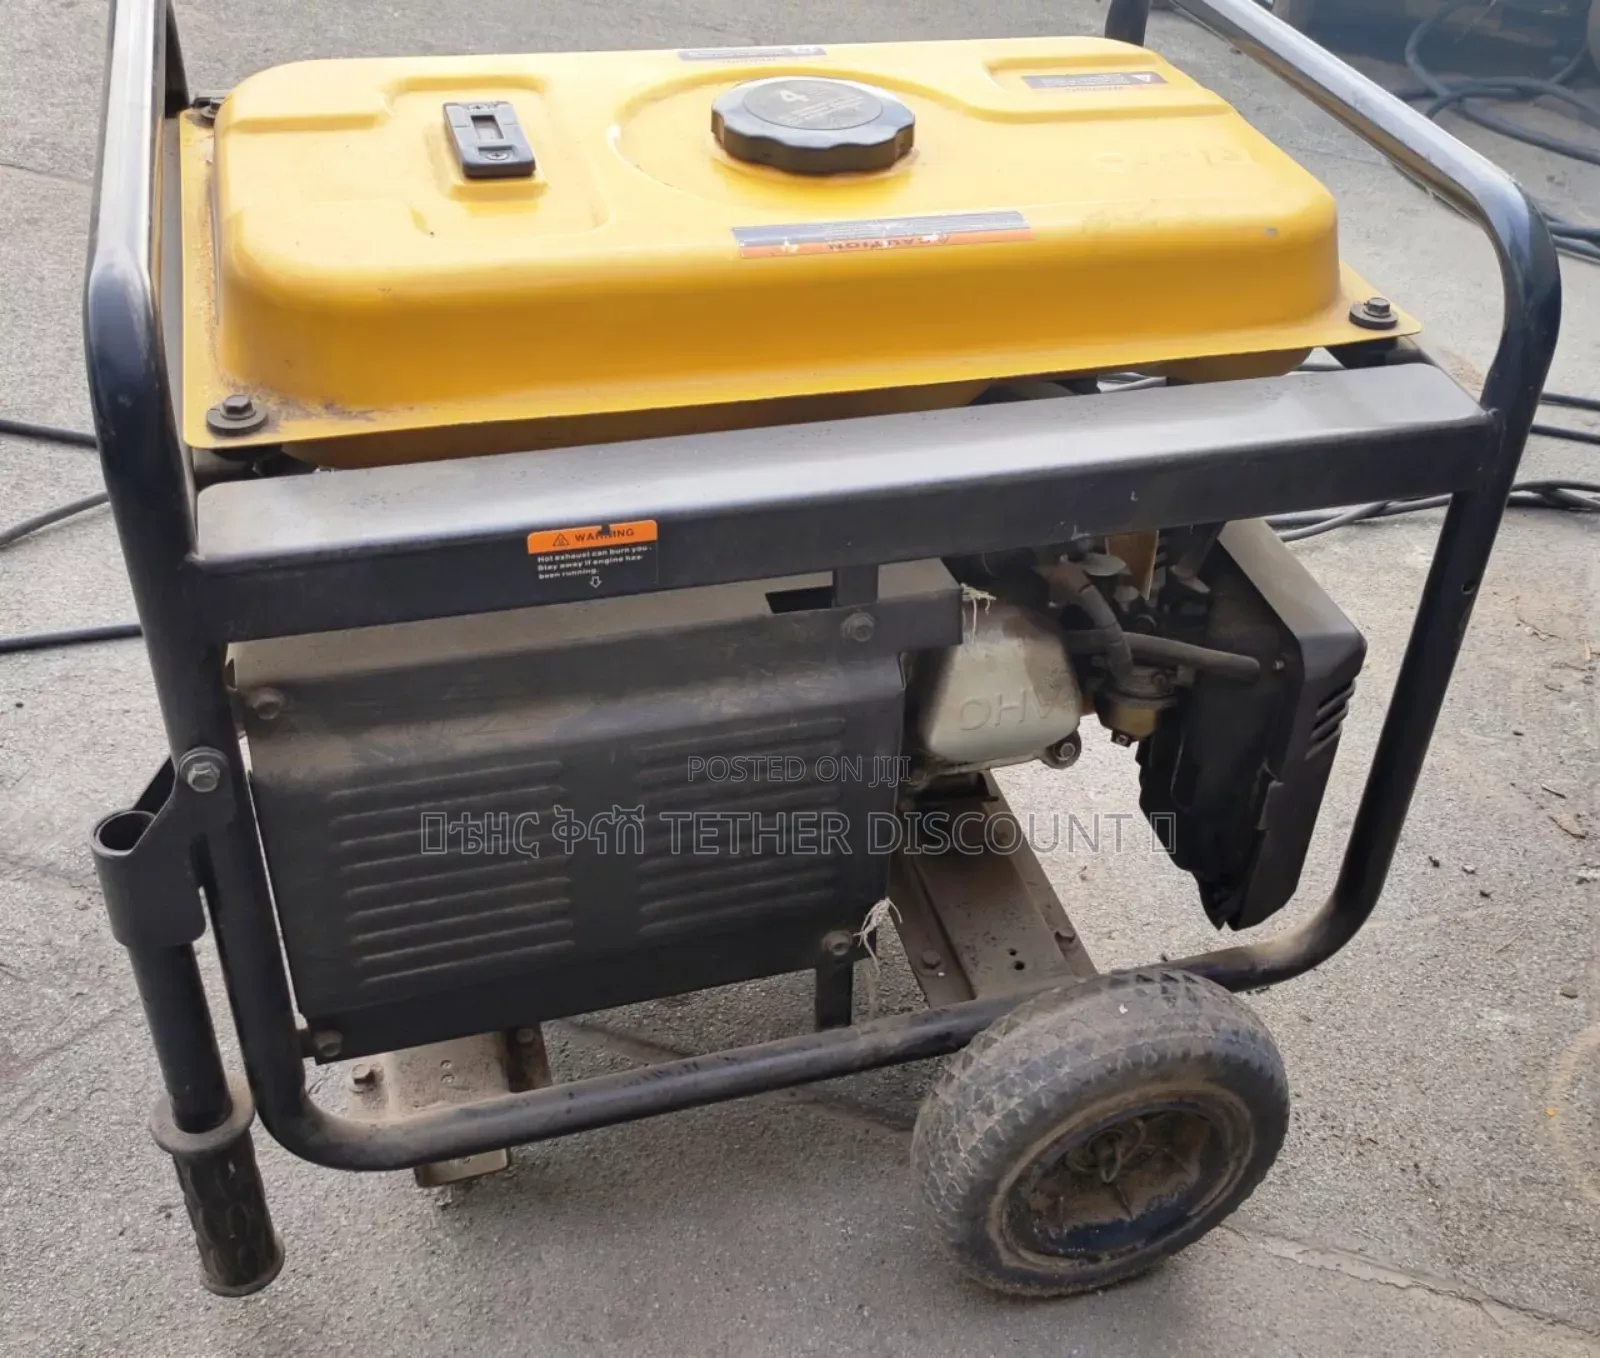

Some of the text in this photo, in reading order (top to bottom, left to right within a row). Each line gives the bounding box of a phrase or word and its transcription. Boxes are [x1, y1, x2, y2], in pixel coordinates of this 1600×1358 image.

[537, 555, 553, 563] Hot
[554, 550, 591, 561] exhaust
[591, 549, 608, 557] can
[609, 547, 630, 556] burn
[559, 560, 583, 570] away
[584, 558, 591, 566] if
[592, 555, 624, 566] engine
[538, 572, 561, 580] been
